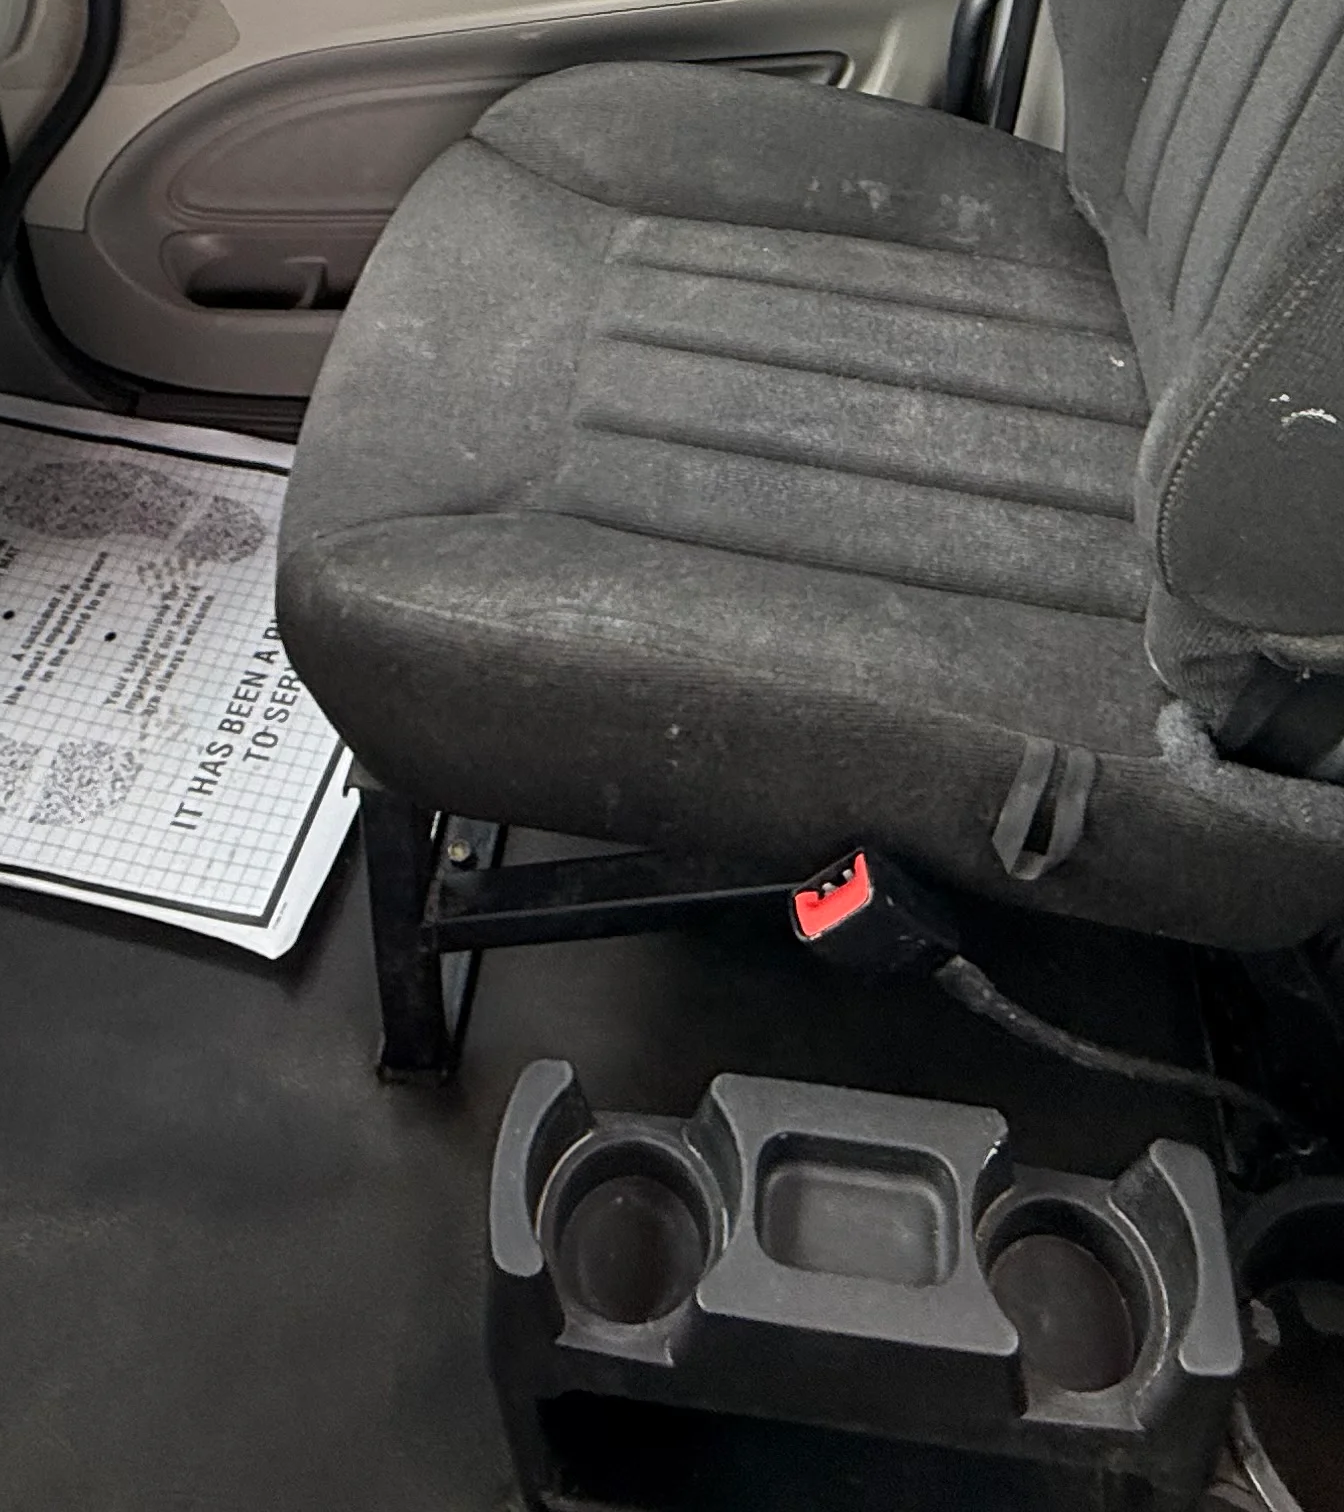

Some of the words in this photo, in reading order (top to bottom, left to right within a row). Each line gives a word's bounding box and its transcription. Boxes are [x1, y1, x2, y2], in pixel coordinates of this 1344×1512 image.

[2, 683, 27, 706] the
[21, 649, 47, 682] most
[38, 591, 86, 648] important
[79, 550, 109, 592] person
[11, 652, 26, 662] A
[21, 596, 62, 650] customer
[38, 670, 56, 683] in
[47, 647, 70, 668] the
[64, 611, 93, 646] world
[83, 599, 101, 611] to
[103, 675, 130, 706] Your
[123, 602, 171, 674] suggestions
[156, 649, 187, 693] always
[179, 593, 215, 646] welcome
[170, 801, 203, 830] IT
[188, 741, 234, 796] HAS
[217, 669, 267, 735] BEEN
[253, 649, 280, 664] A
[242, 731, 279, 762] TO
